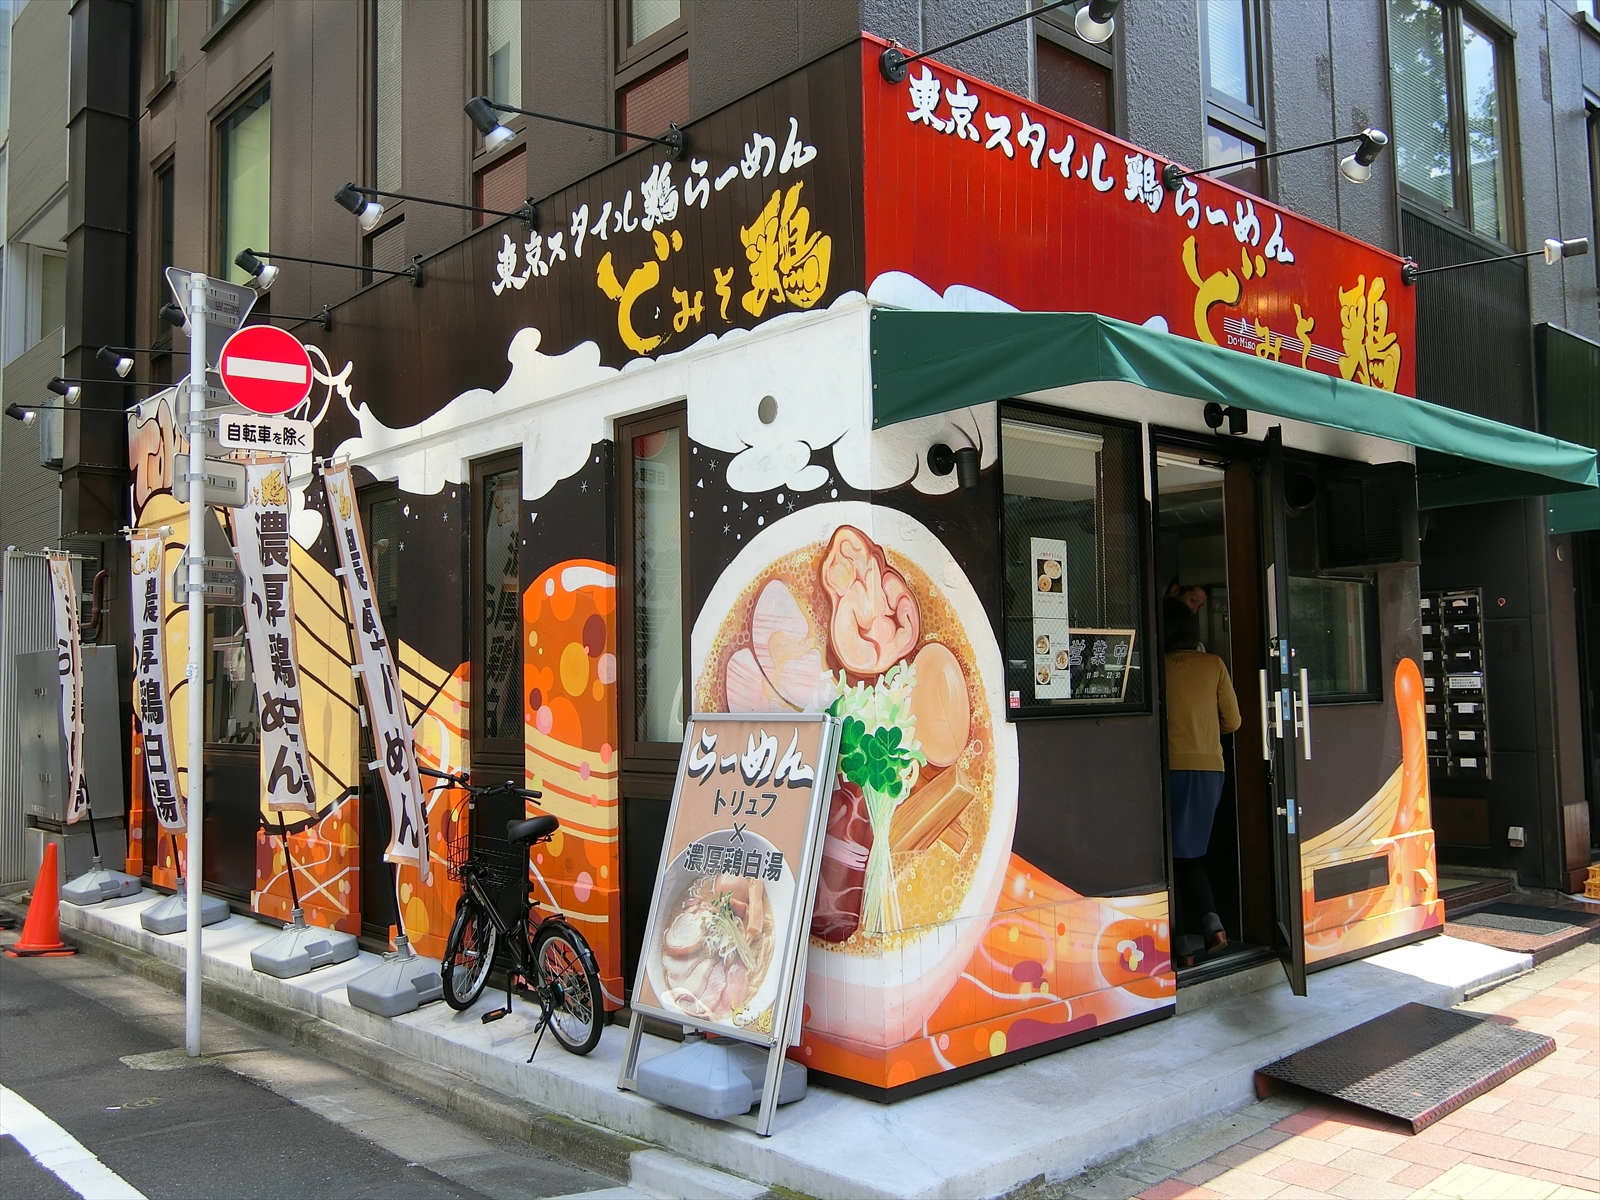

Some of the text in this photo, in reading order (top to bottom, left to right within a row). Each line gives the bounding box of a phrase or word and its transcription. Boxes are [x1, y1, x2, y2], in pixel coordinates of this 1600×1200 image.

[491, 115, 818, 296] 東京スタイル鶏らーめん
[227, 422, 306, 447] 自転車を除く
[1070, 639, 1129, 666] 営業中
[687, 726, 815, 789] らーめん
[713, 788, 779, 820] トリュフ
[683, 842, 786, 883] 濃厚鶏白湯
